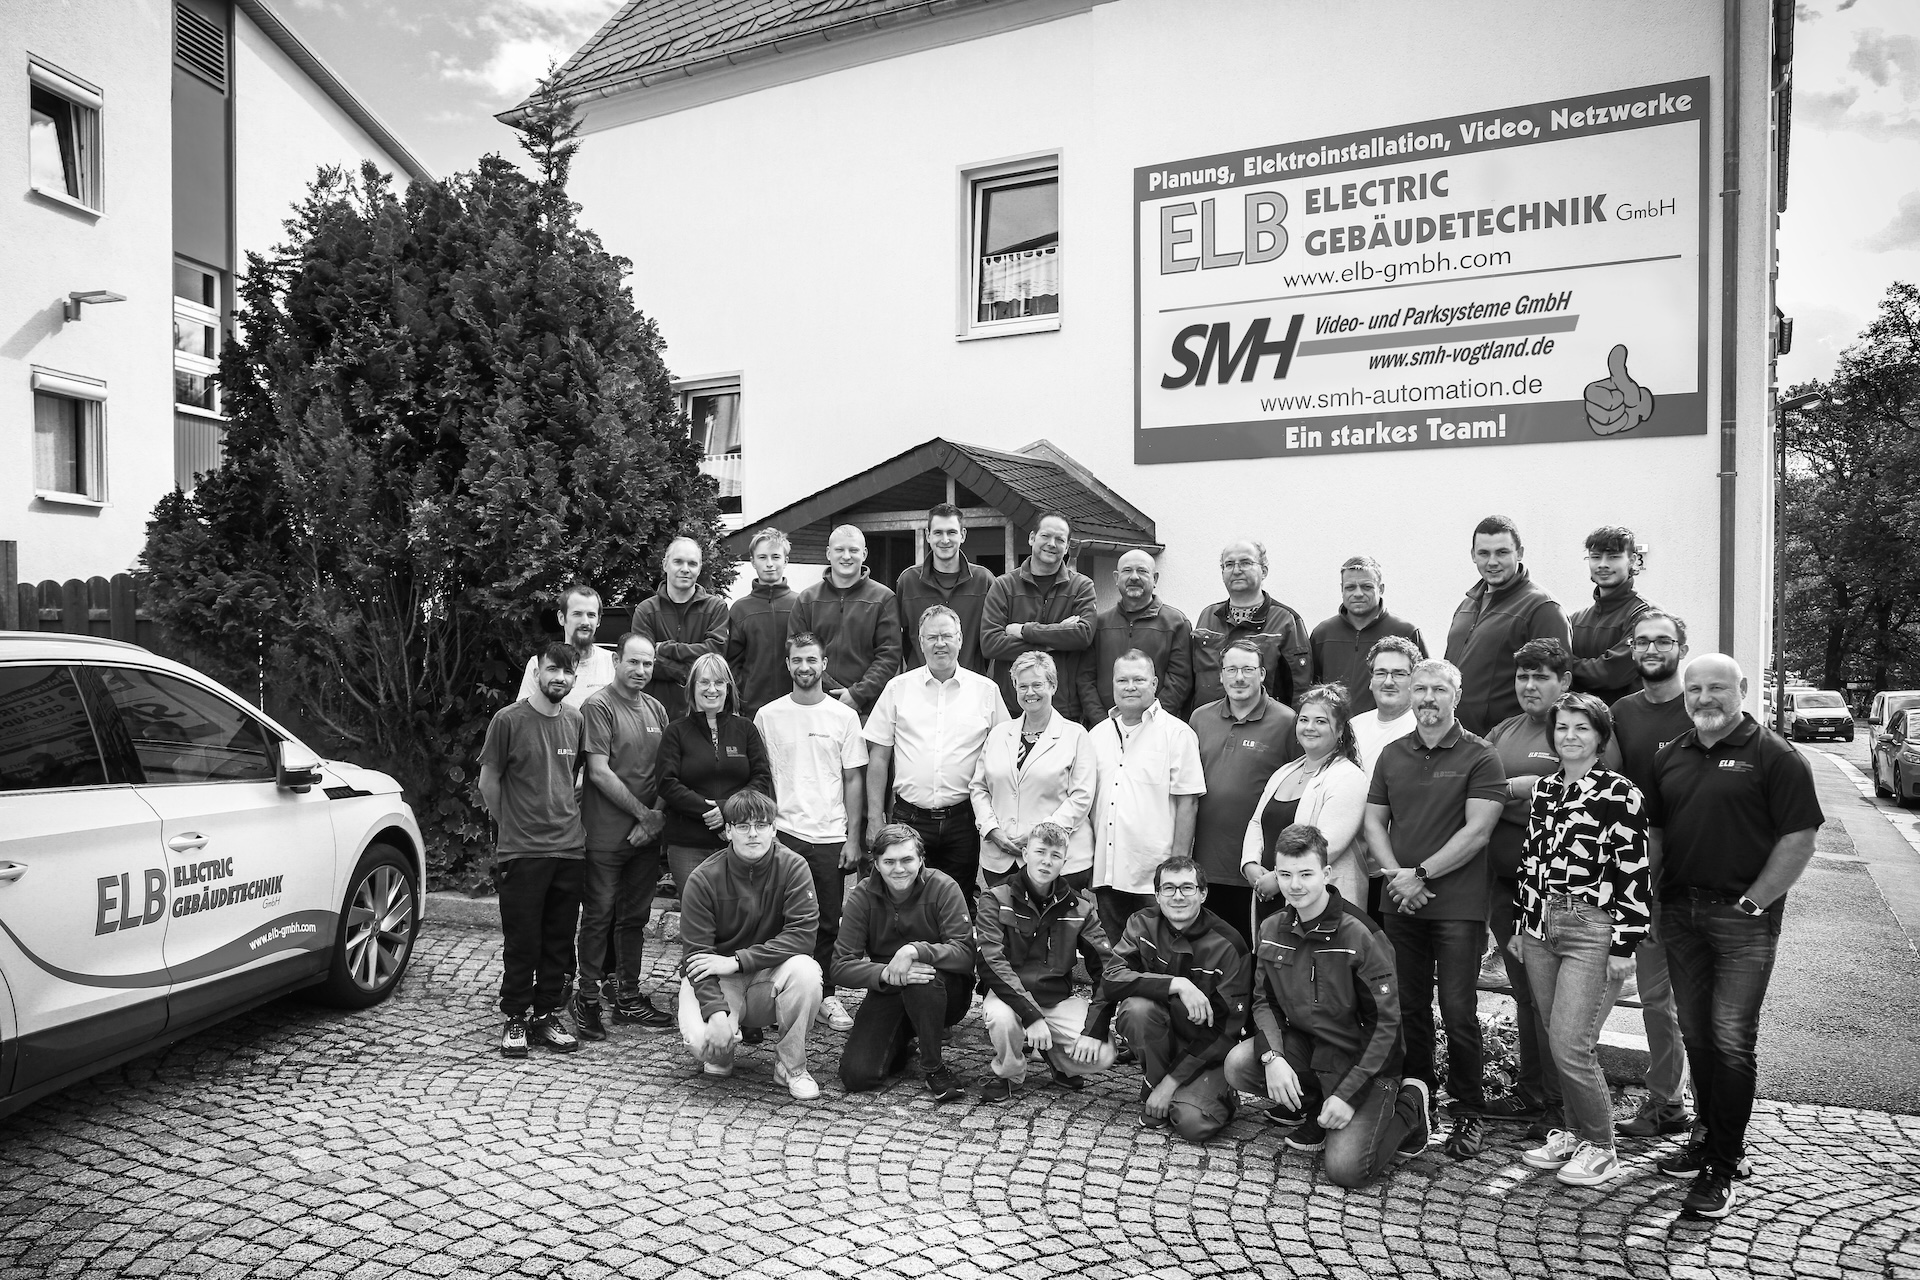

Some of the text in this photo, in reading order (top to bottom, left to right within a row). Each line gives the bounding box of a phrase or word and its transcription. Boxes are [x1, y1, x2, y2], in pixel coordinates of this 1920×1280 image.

[1149, 92, 1693, 191] Planung, Elektroinstallation, Video, Netzwerke
[1305, 169, 1449, 215] ELECTRIC
[1160, 191, 1289, 275] ELB
[1305, 193, 1676, 256] GEBÄUDETECHNIK GmbH
[1283, 250, 1511, 288] www.elb-gmbh.com
[1315, 290, 1573, 335] Video- und Parksysteme GmbH
[1160, 313, 1305, 390] SMH
[1369, 336, 1554, 370] www.smh-vogtland.de
[1260, 375, 1543, 412] www.smh-automation.de
[1285, 413, 1506, 449] Ein starkes Team!
[1718, 759, 1735, 767] ELB
[173, 856, 234, 888] ELECTRIC
[95, 868, 167, 937] ELB
[172, 874, 284, 918] GEBÄUDETECHNIK
[262, 896, 282, 910] GmbH
[249, 921, 317, 951] www.elb-gmbh.com
